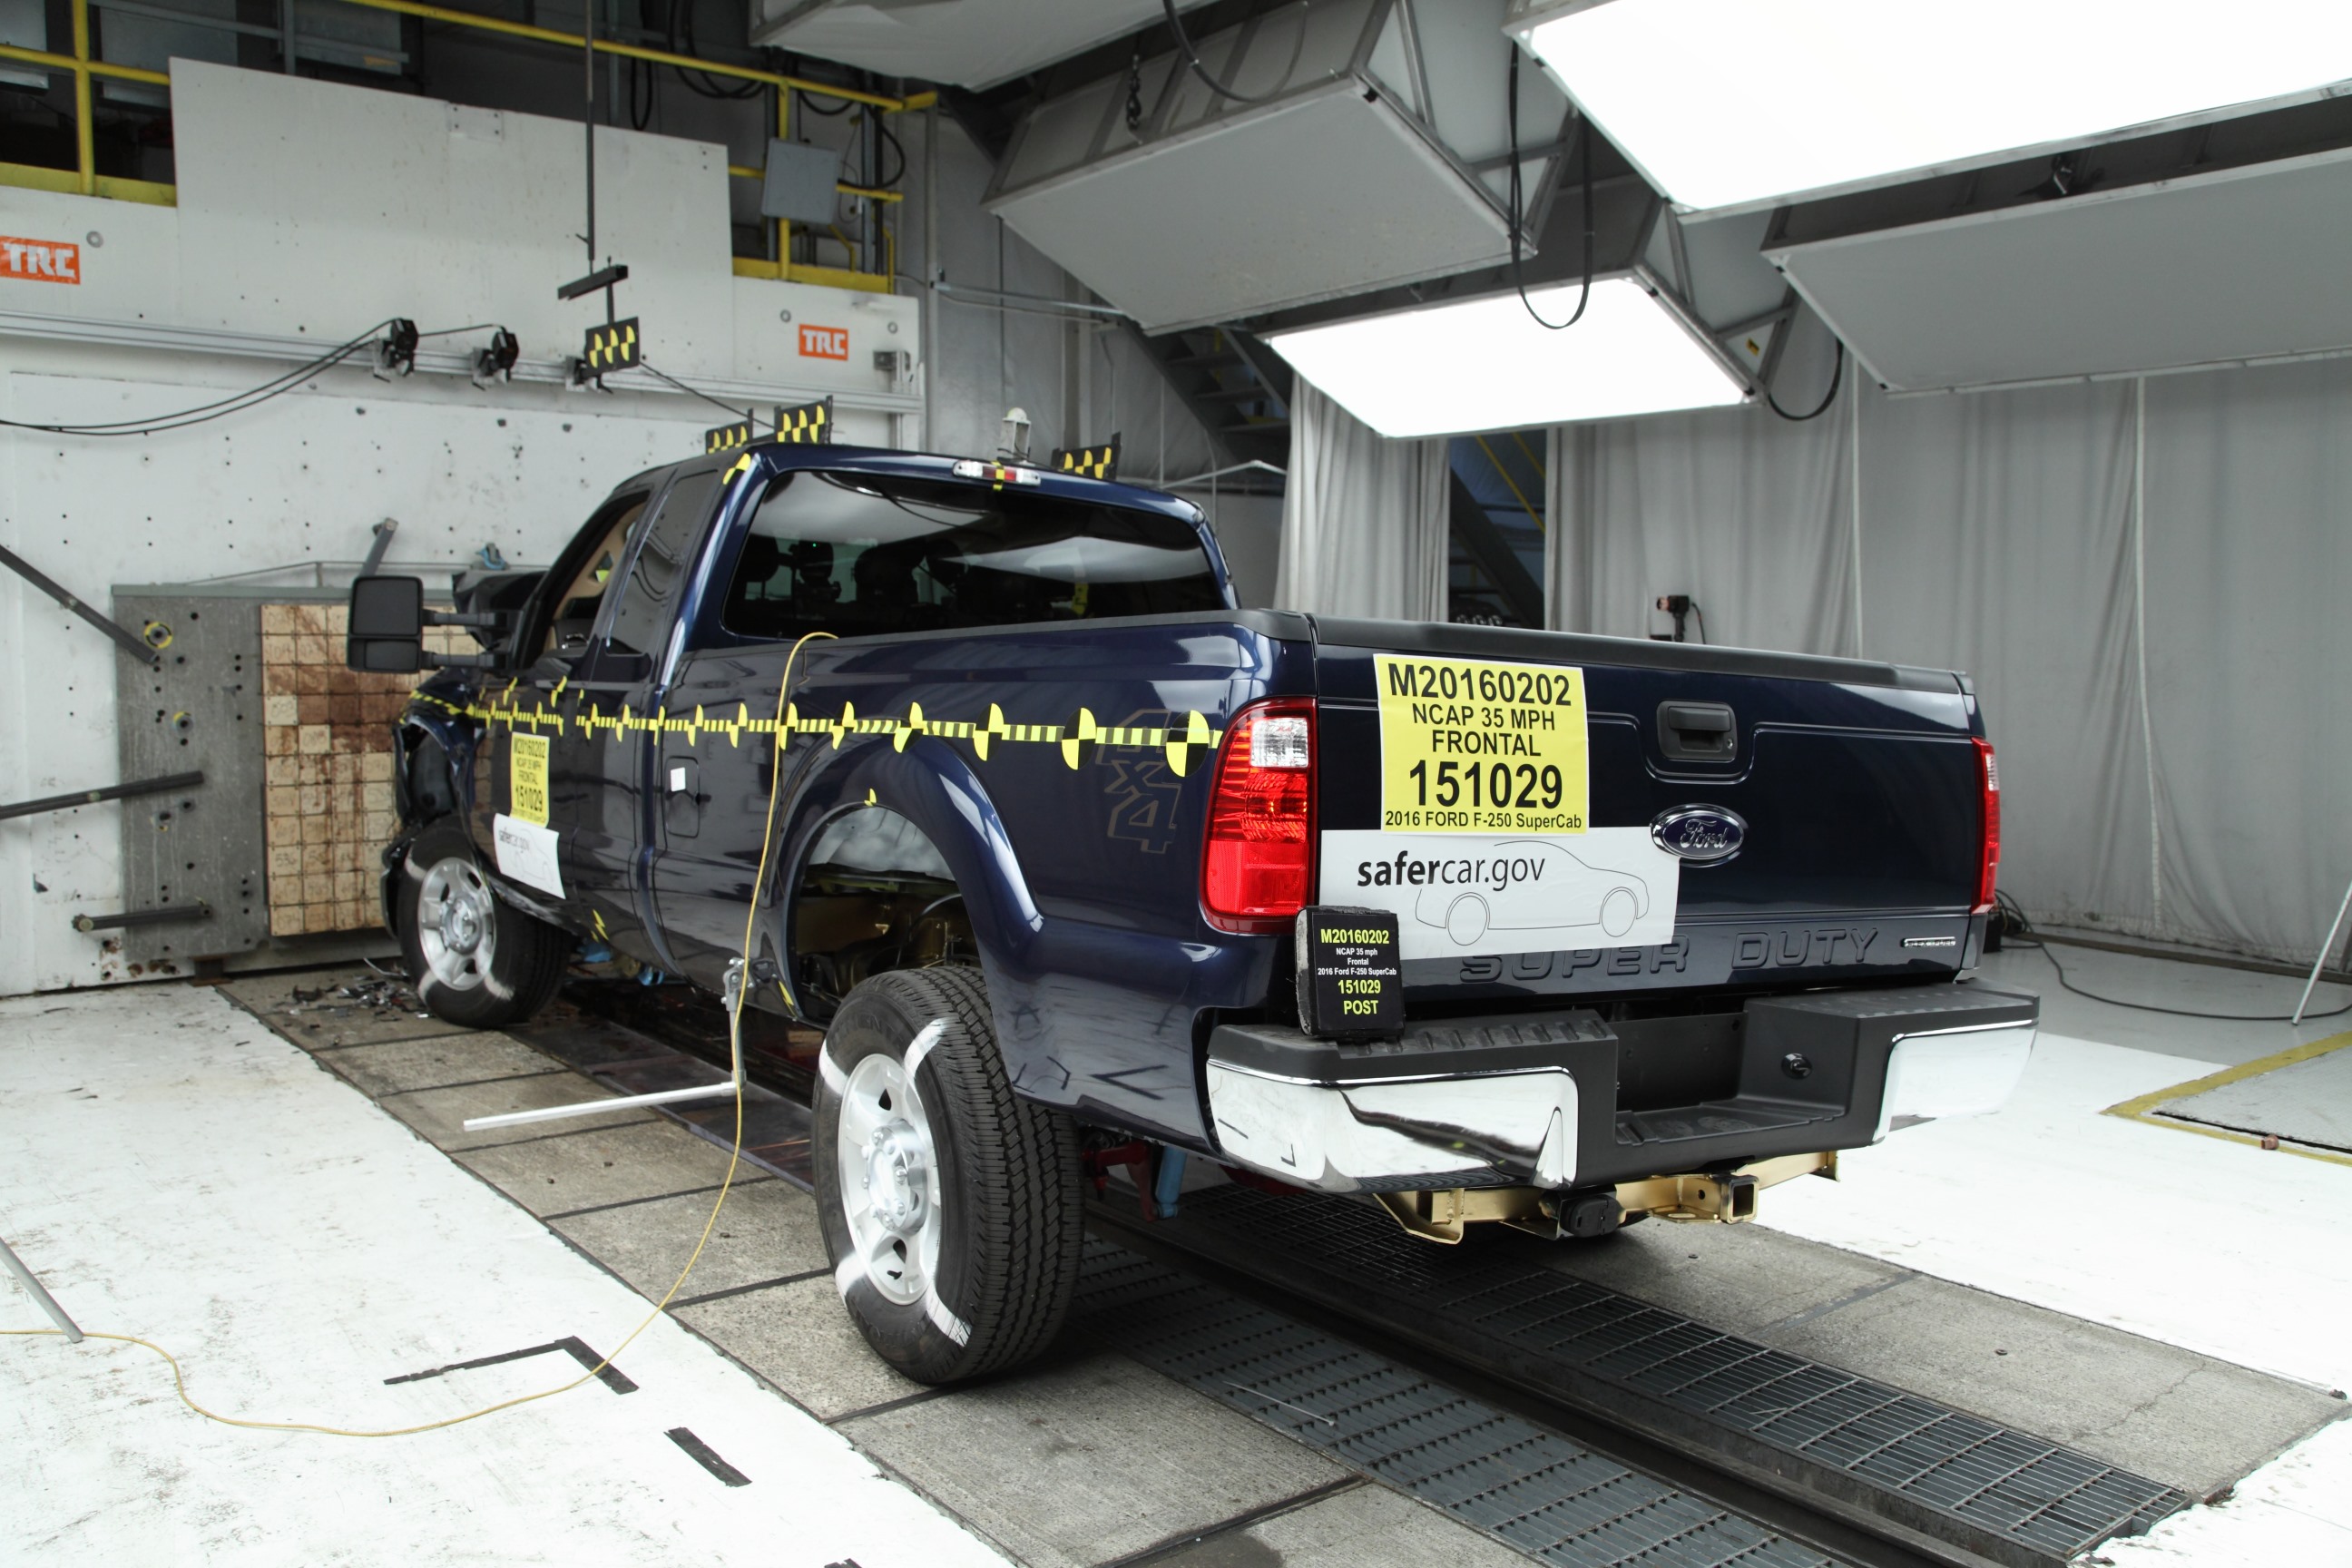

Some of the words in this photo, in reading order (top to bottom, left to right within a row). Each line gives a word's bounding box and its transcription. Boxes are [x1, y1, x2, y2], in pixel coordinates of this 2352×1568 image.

[3, 242, 75, 279] TRC
[802, 328, 846, 356] TRC
[1387, 662, 1572, 707] M20160202
[1412, 703, 1475, 726] NCAP
[1481, 707, 1504, 729] 35
[1511, 709, 1555, 730] MPH
[1432, 730, 1542, 757] FRONTAL
[1409, 760, 1563, 809] 151029
[1385, 810, 1421, 827] 2016
[1426, 811, 1469, 827] FORD
[1474, 811, 1512, 828] F-250
[1516, 813, 1582, 831] SuperCab
[1680, 818, 1729, 848] Ford
[1357, 850, 1545, 891] safercar.gov
[1320, 928, 1390, 945] M20160202
[1336, 947, 1355, 956] NCAP
[1356, 947, 1364, 956] 35
[1365, 948, 1378, 957] mph
[1347, 957, 1369, 965] Frontal
[1459, 935, 1690, 983] SUPER
[1731, 927, 1878, 969] DUTY
[1318, 967, 1333, 975] 2016
[1334, 967, 1349, 975] Ford
[1350, 967, 1367, 975] F-250
[1368, 967, 1397, 976] SuperCab
[1338, 979, 1381, 995] 151029
[1343, 1000, 1379, 1015] POST
